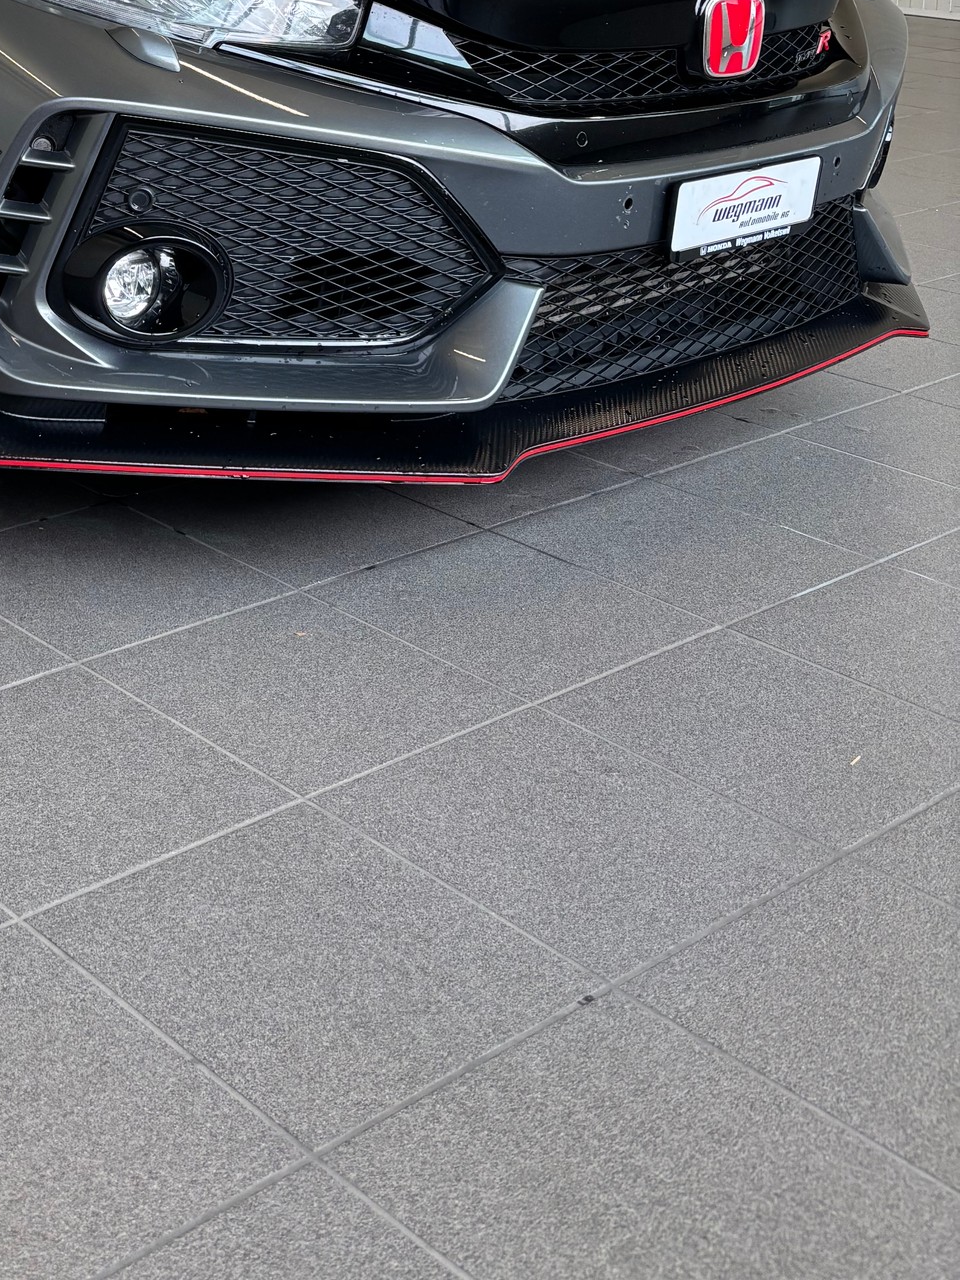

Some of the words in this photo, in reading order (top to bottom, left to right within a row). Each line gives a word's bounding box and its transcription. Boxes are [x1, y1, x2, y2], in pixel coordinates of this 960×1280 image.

[711, 194, 783, 223] wegmann
[738, 211, 780, 229] automobile
[707, 241, 732, 253] HONDA
[735, 233, 763, 247] Wegmann
